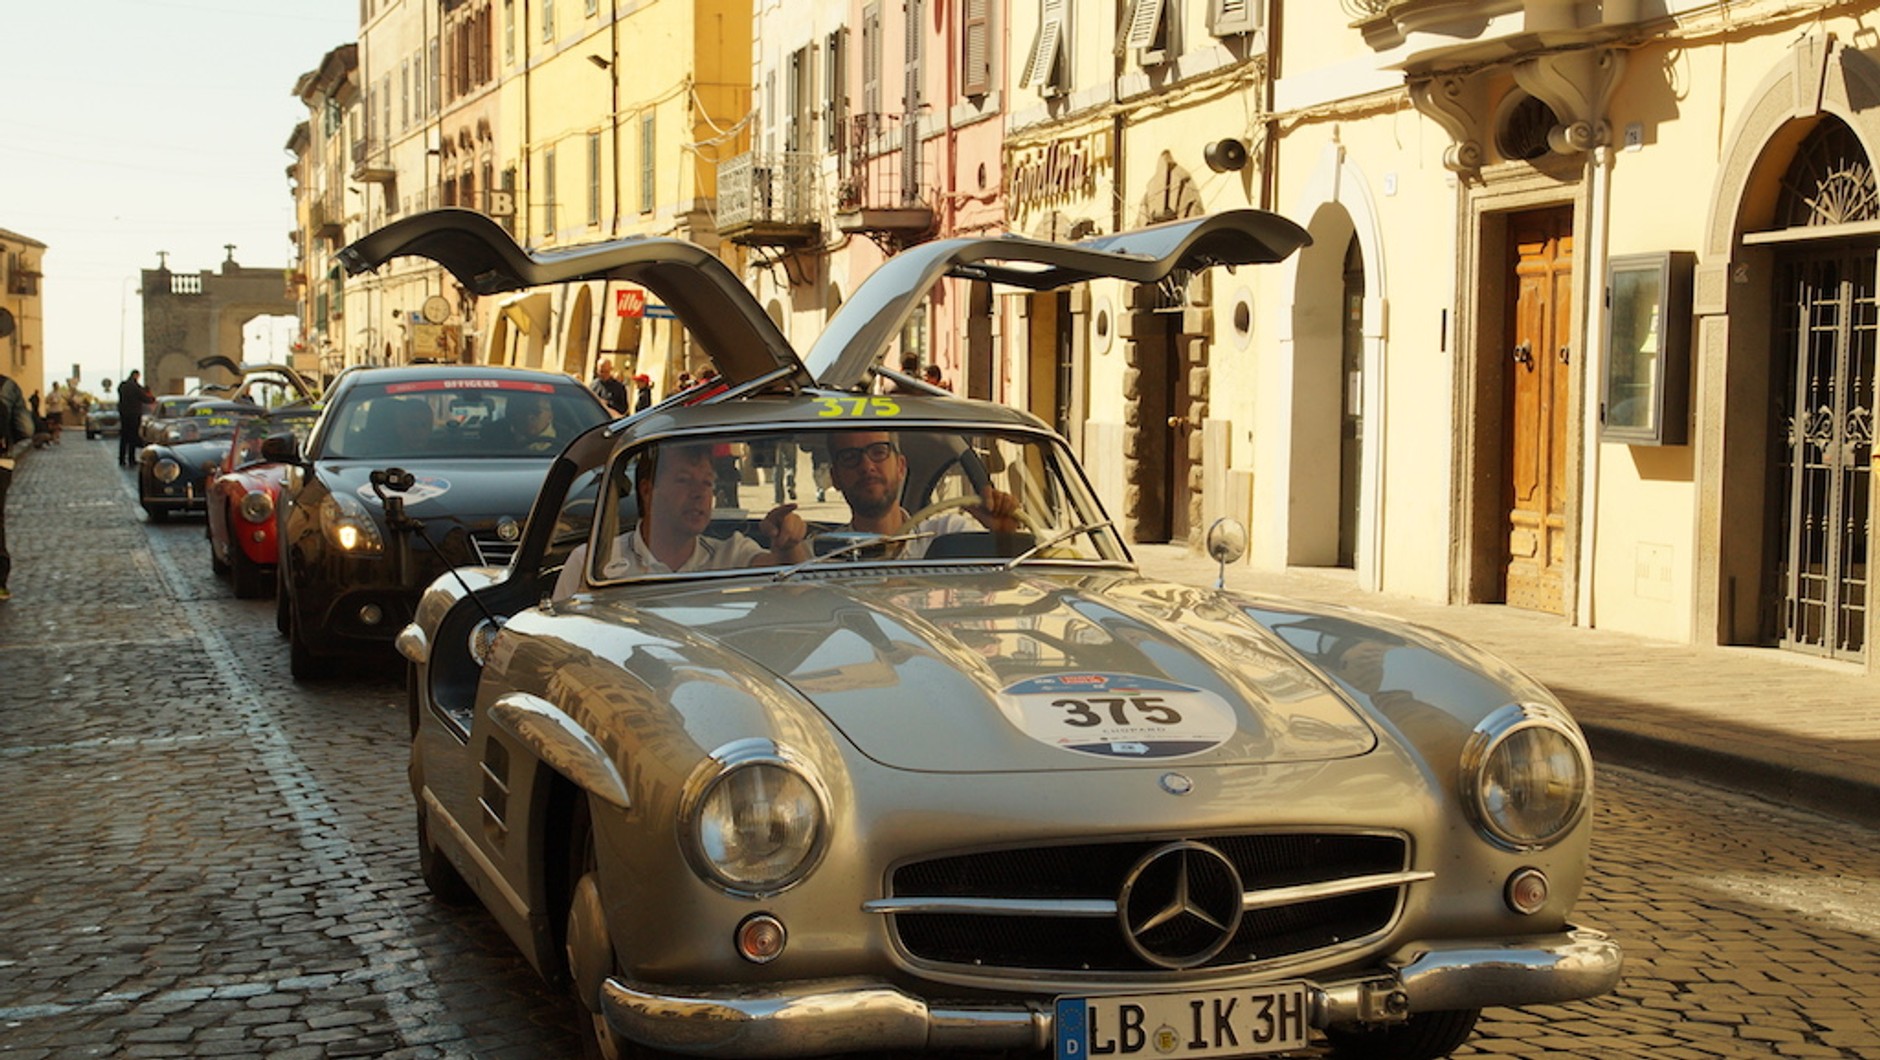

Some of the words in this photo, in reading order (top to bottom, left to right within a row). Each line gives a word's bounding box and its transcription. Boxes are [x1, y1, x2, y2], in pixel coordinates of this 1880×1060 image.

[490, 192, 514, 215] B
[618, 293, 642, 315] illy
[444, 379, 499, 388] OFFICERS
[812, 397, 900, 417] 375
[1052, 697, 1182, 727] 375
[1088, 1004, 1146, 1055] LB
[1187, 997, 1239, 1050] IK
[1251, 992, 1303, 1043] 3H
[1066, 1039, 1079, 1055] D
